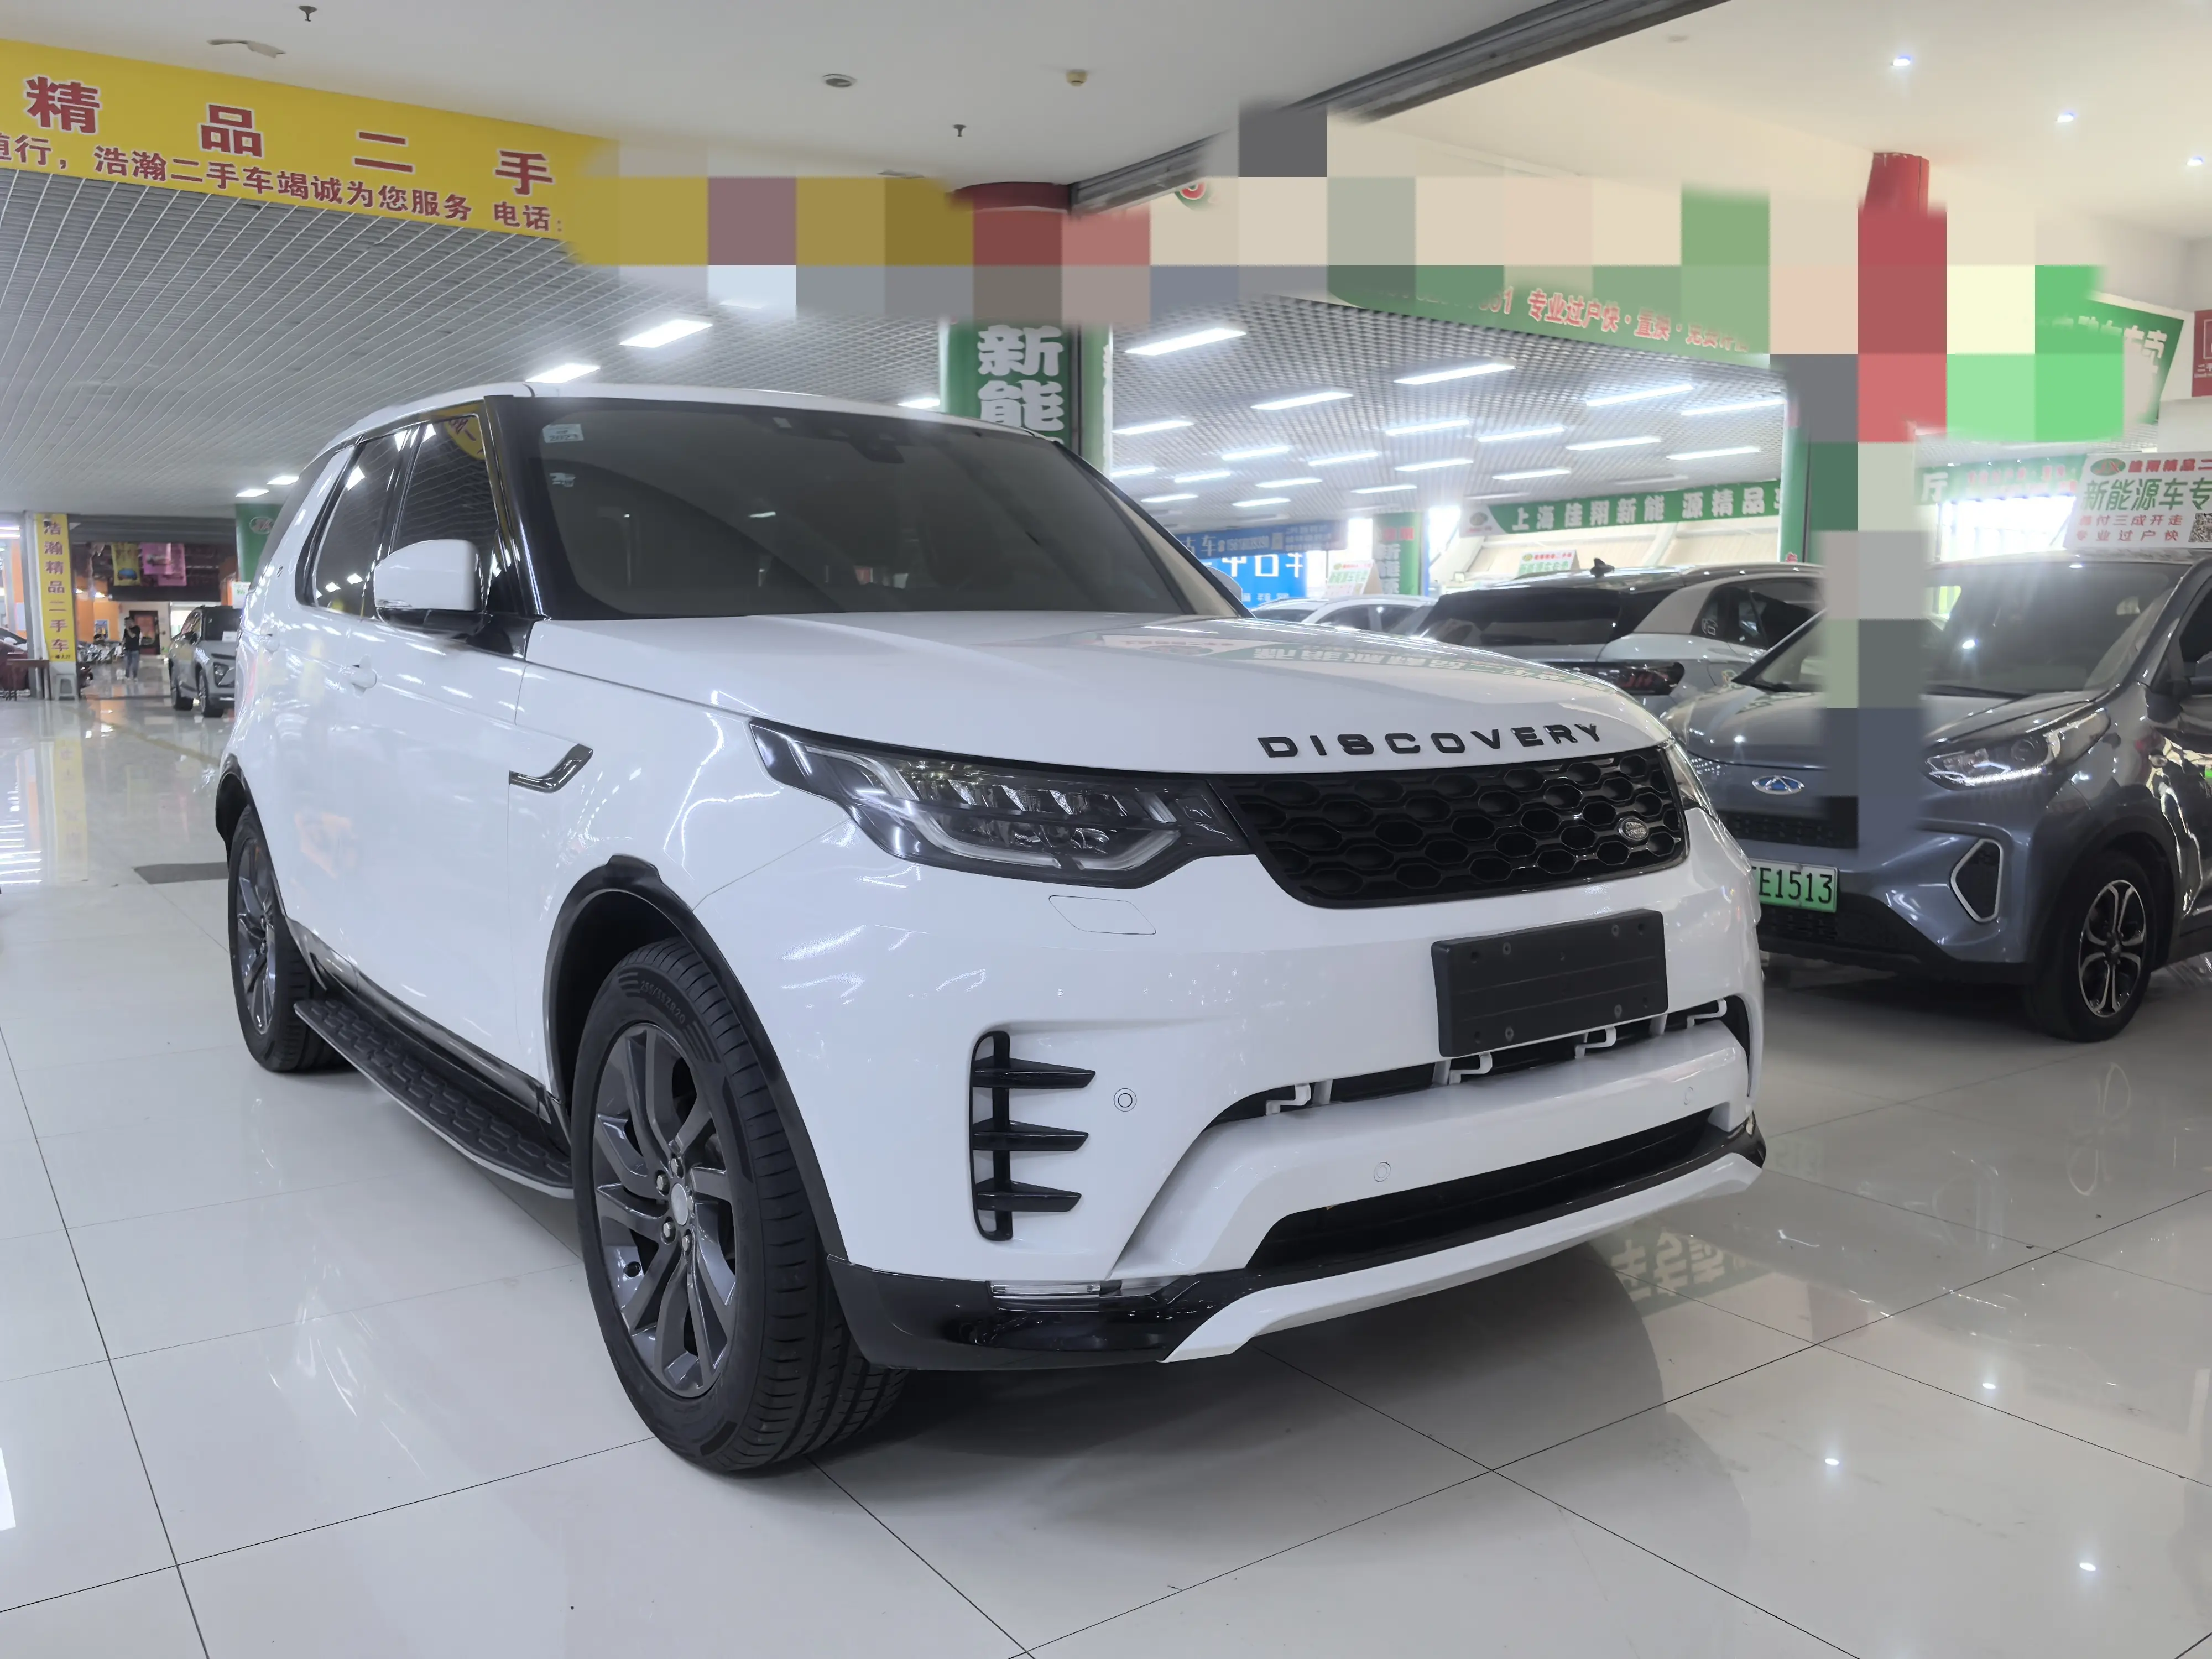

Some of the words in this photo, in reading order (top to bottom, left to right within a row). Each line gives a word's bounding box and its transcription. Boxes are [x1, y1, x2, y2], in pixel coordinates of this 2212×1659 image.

[977, 324, 1065, 444] 新能
[1258, 723, 1601, 758] DISCOVERY
[1752, 866, 1833, 904] E1513
